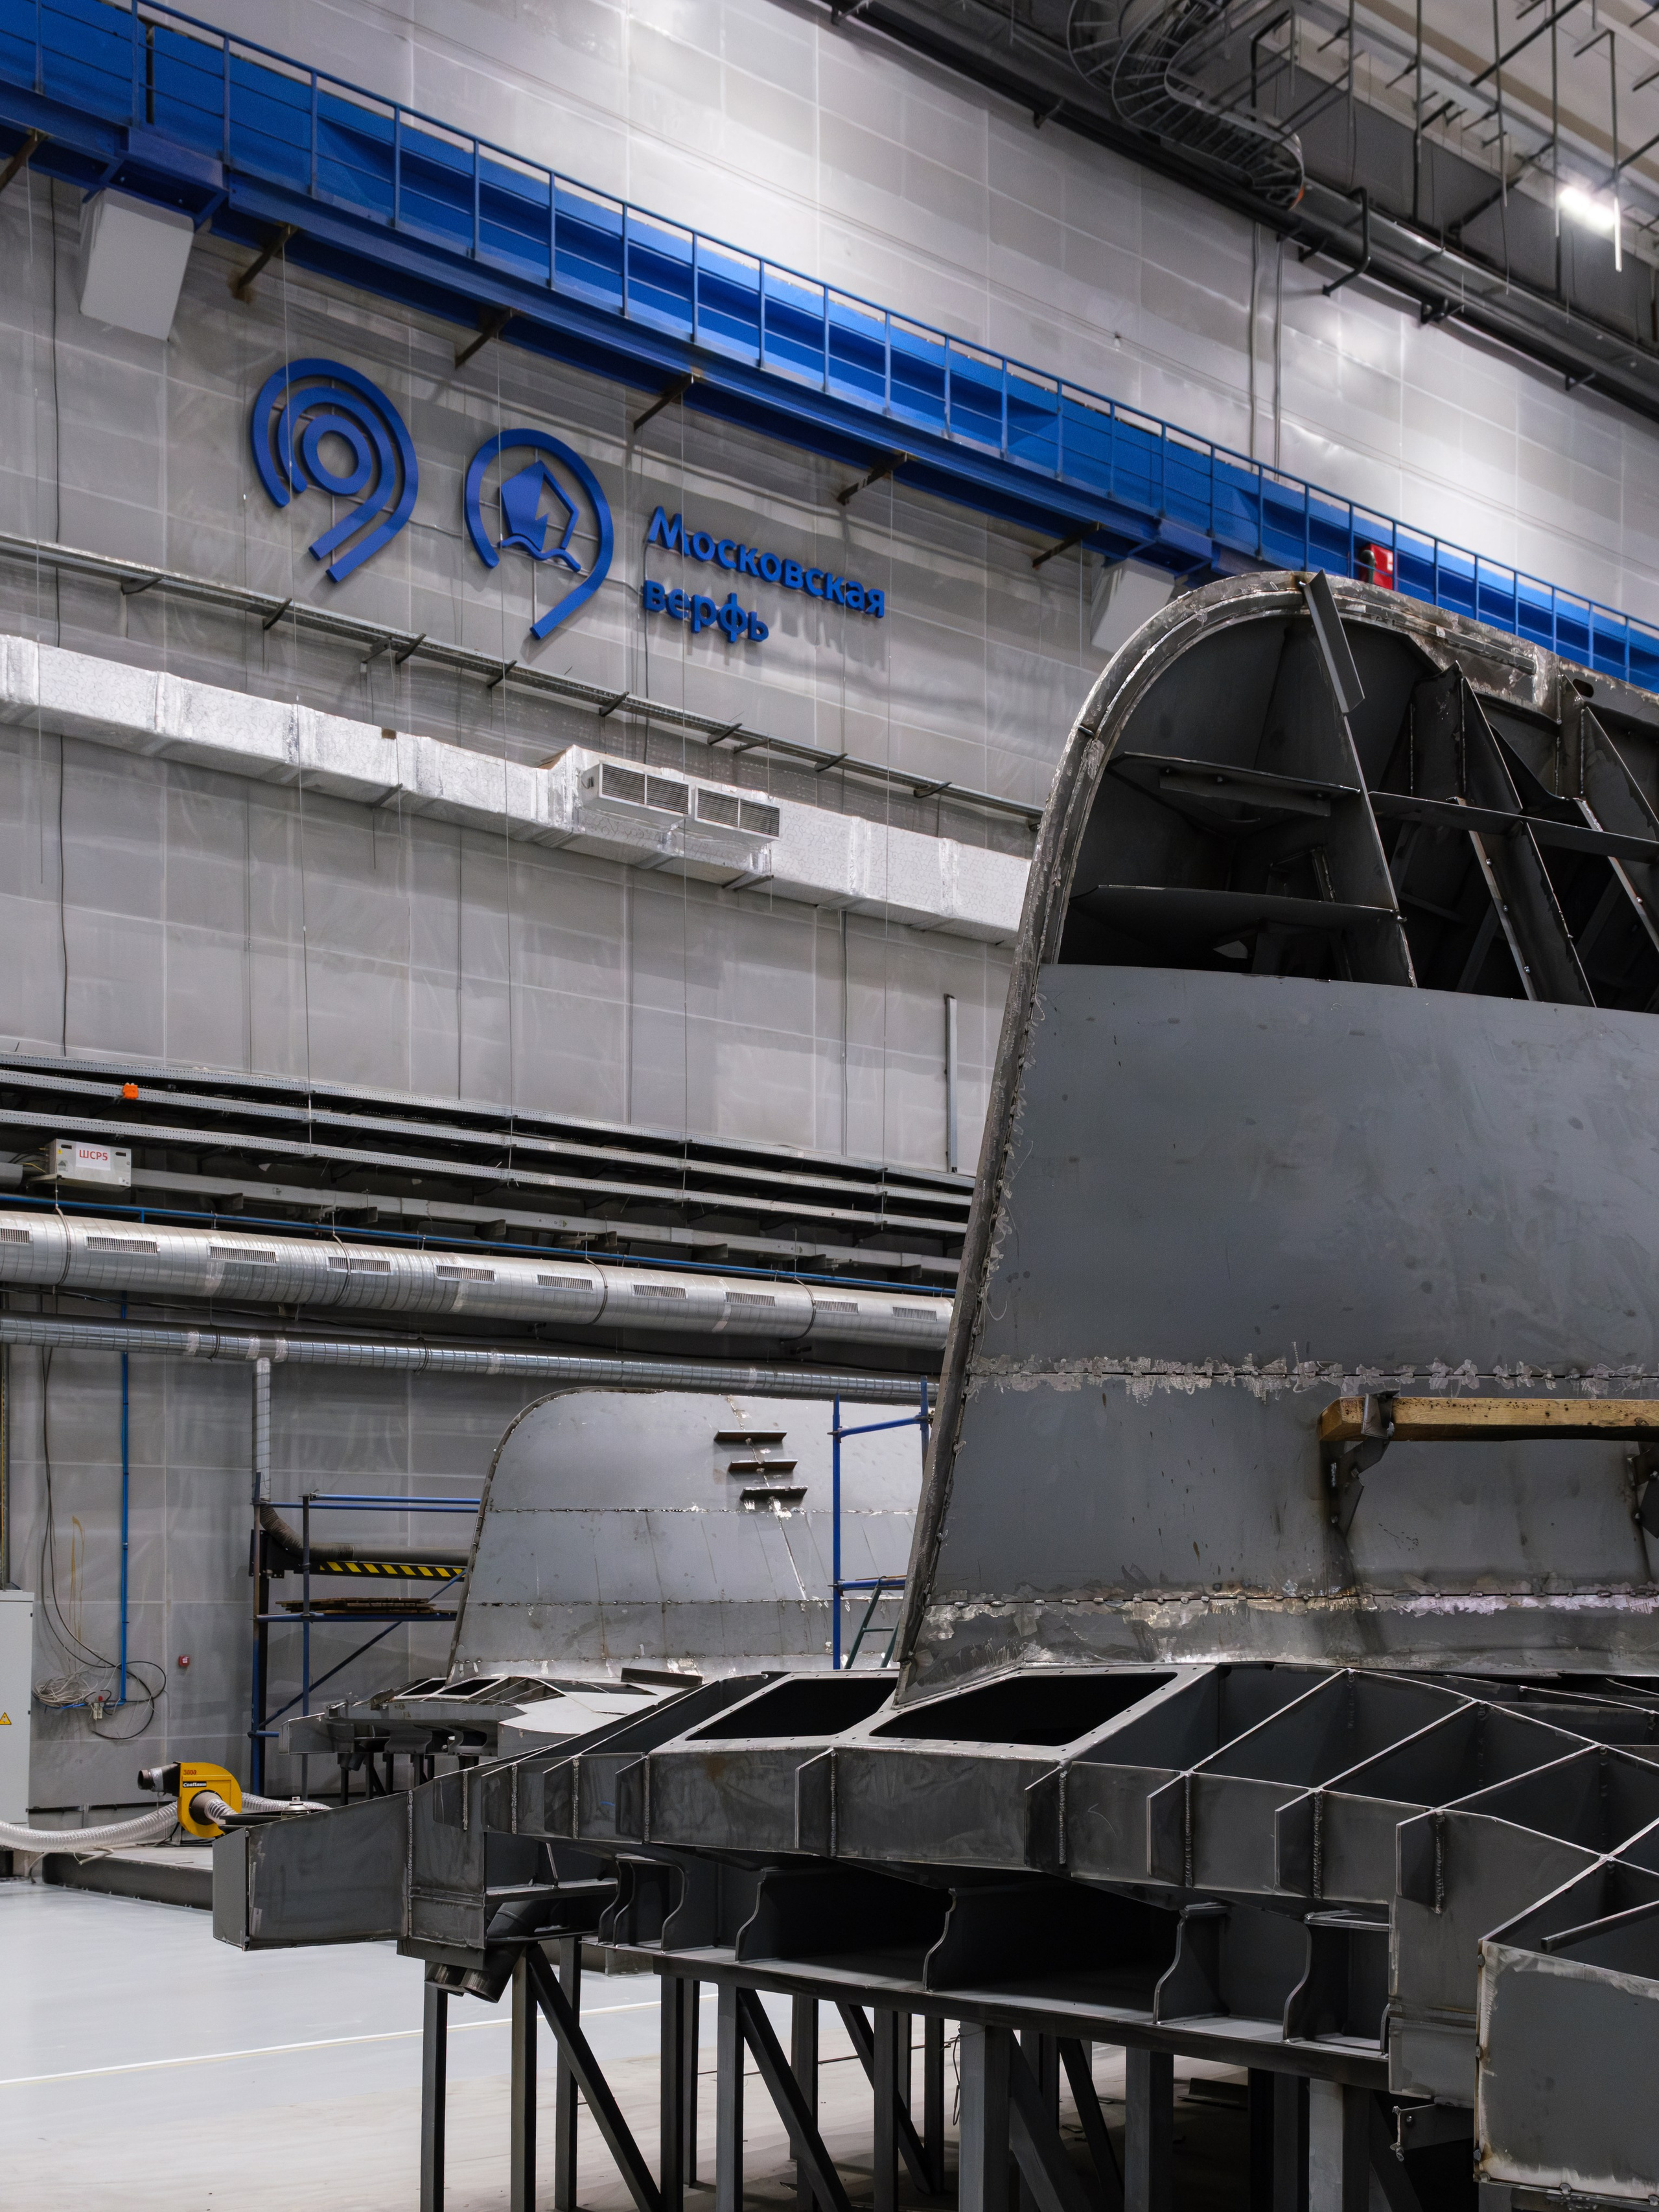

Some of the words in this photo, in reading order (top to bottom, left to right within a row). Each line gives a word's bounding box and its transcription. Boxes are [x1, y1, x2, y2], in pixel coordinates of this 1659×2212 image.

[648, 506, 885, 618] Московская
[644, 579, 769, 643] верфь
[79, 1150, 108, 1161] ШСР5
